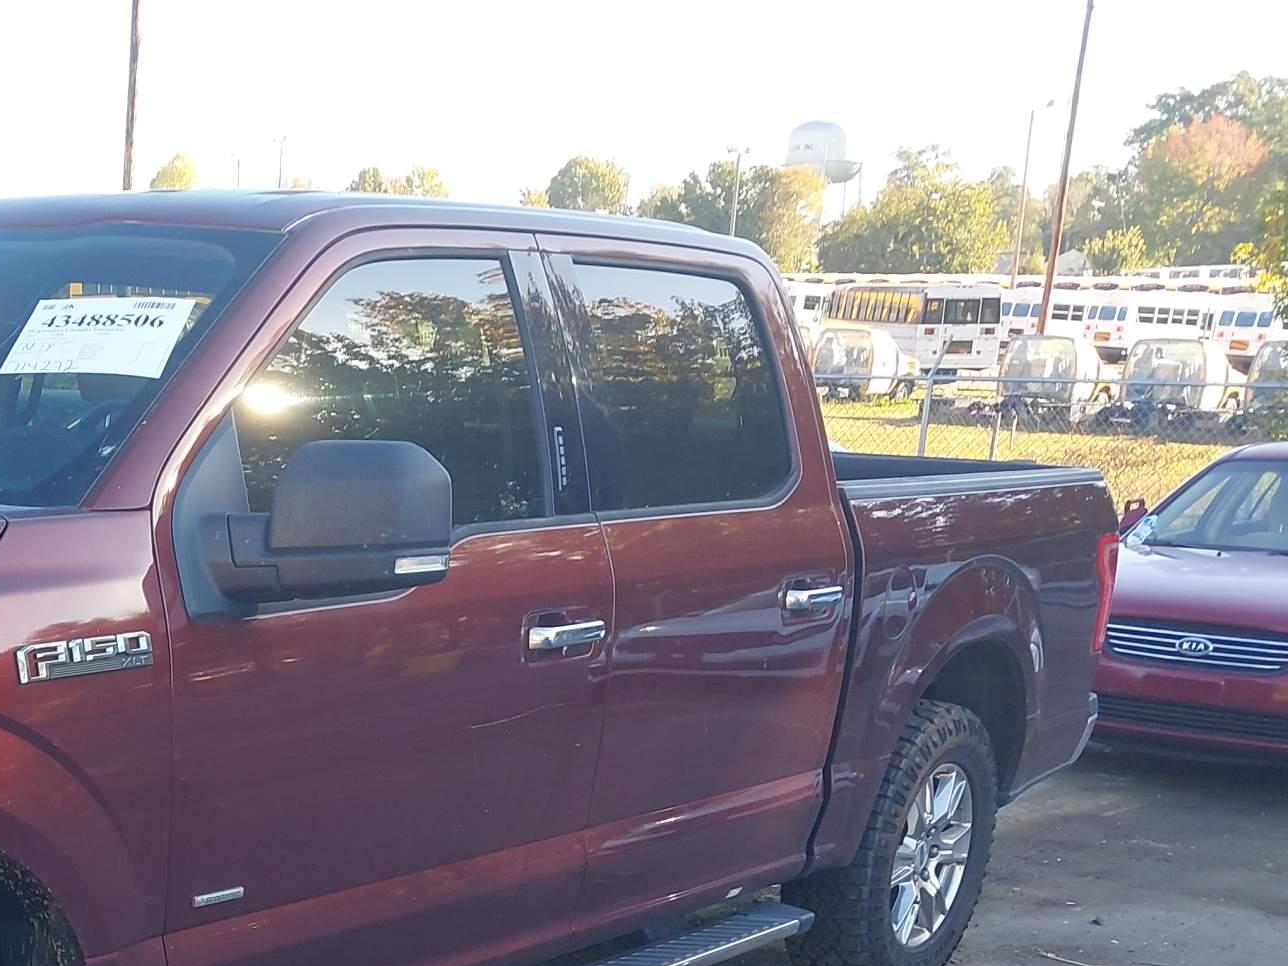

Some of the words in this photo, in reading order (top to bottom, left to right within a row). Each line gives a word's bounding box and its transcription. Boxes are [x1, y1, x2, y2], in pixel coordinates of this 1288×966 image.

[41, 313, 168, 329] 43488506
[1181, 641, 1205, 651] KIA
[122, 656, 149, 667] XLT
